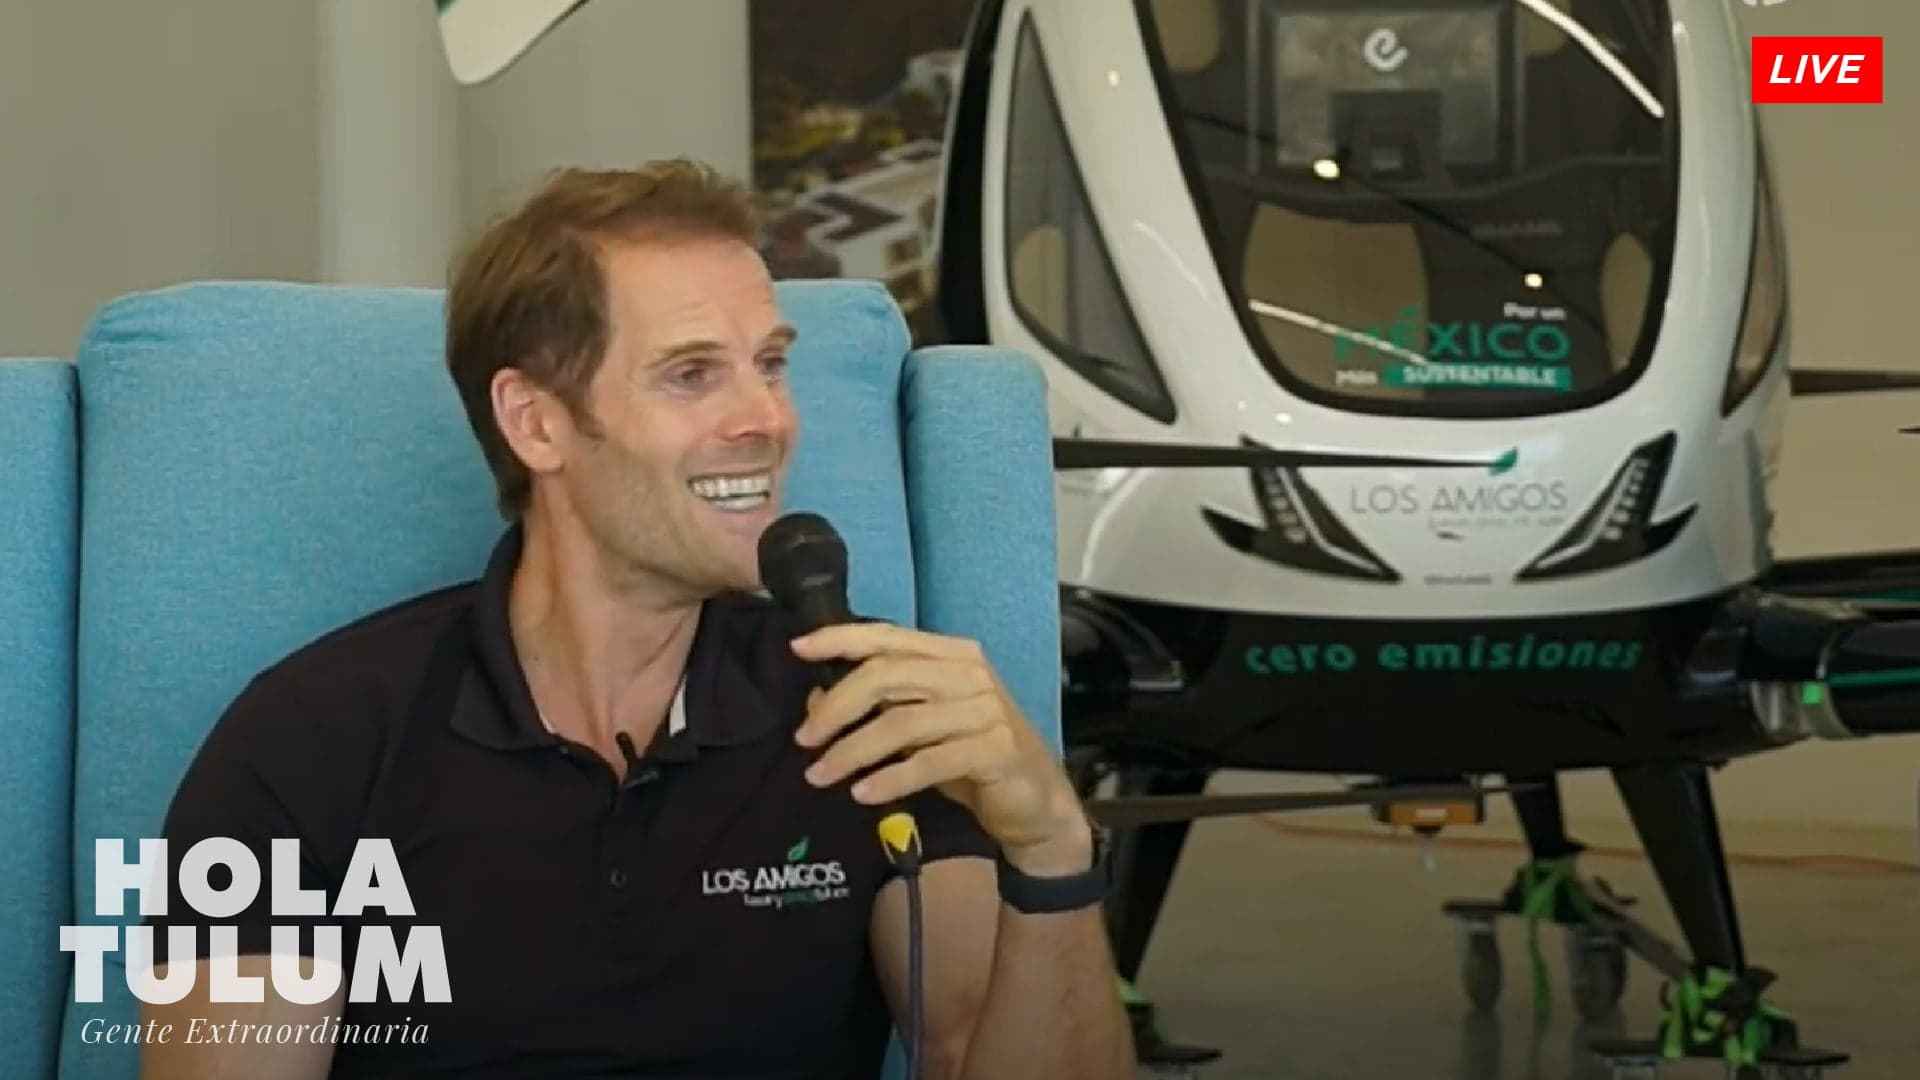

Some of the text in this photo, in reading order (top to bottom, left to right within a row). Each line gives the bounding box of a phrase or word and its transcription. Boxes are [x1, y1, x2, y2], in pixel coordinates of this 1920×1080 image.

[1350, 480, 1567, 514] LOS AMIGOS
[1244, 634, 1643, 674] cero emisiones
[702, 861, 846, 894] LOS AMIGOS
